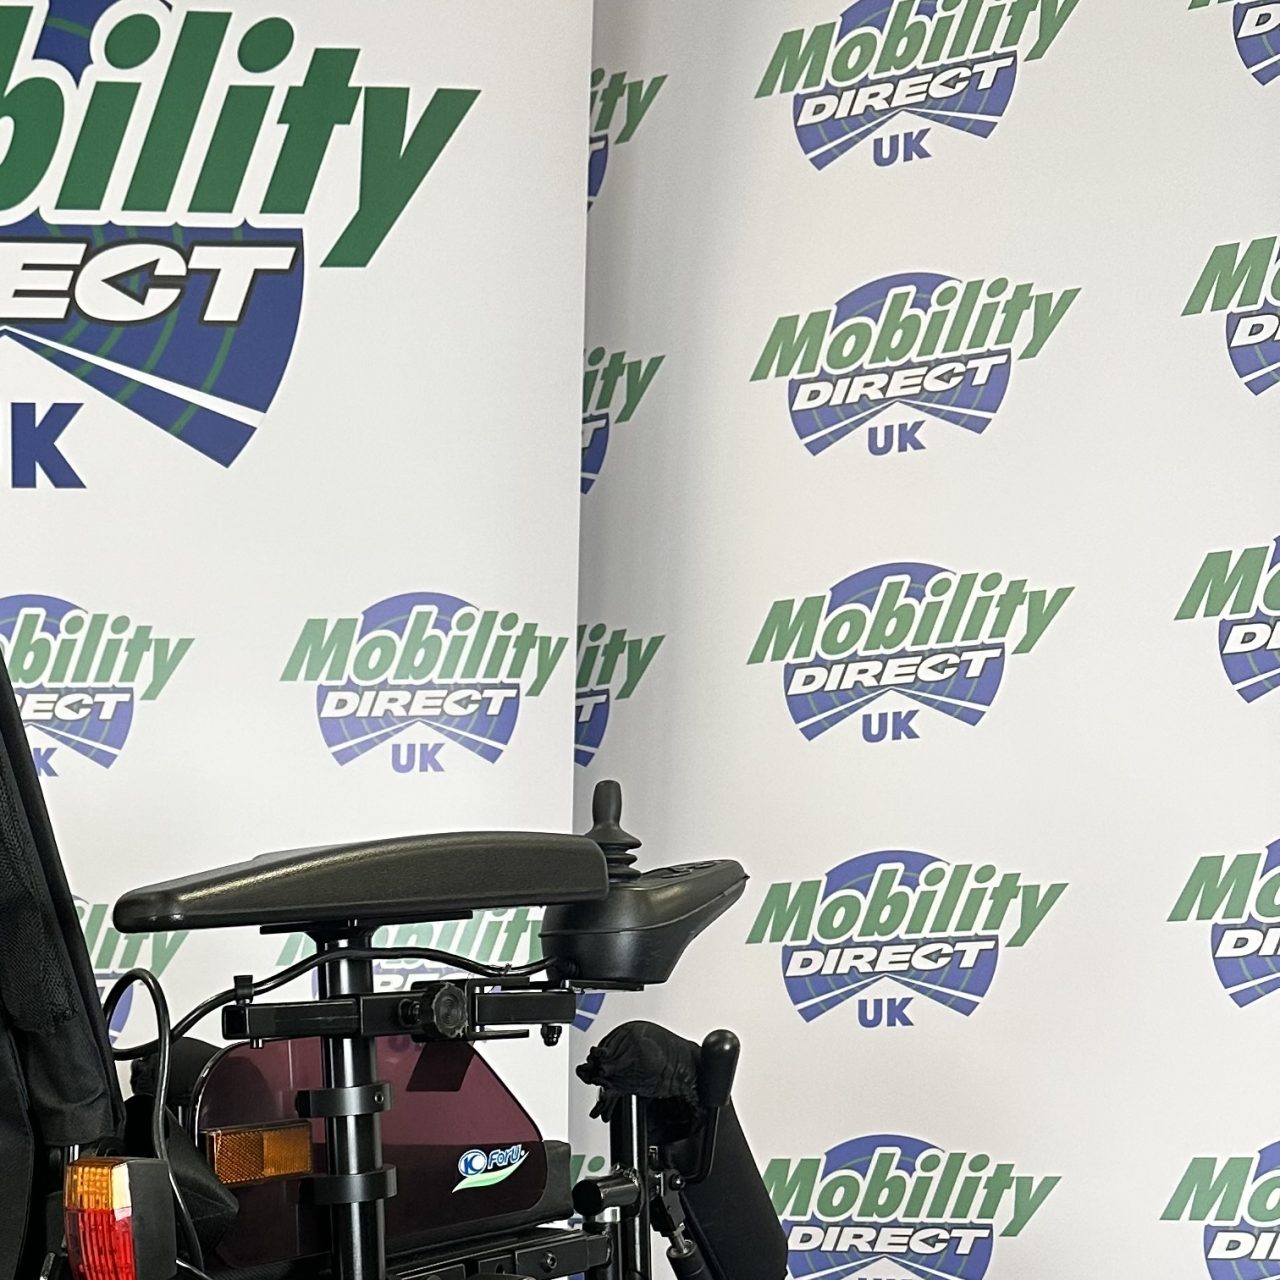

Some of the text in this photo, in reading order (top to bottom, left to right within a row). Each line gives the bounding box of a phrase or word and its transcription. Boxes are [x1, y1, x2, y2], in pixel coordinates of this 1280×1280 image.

[797, 56, 1014, 126] DIRECT
[873, 127, 932, 167] UK
[749, 277, 1082, 382] Mobility
[792, 355, 1008, 411] DIRECT
[868, 420, 926, 456] UK
[746, 571, 1075, 665] Mobility
[0, 613, 196, 700] bility
[279, 611, 570, 697] Mobility
[788, 649, 1003, 695] DIRECT
[320, 689, 518, 717] DIRECT
[862, 710, 920, 743] UK
[391, 743, 445, 773] UK
[745, 864, 1069, 947] Mobility
[785, 941, 996, 976] DIRECT
[858, 997, 914, 1028] UK
[788, 1226, 990, 1254] DIRECT
